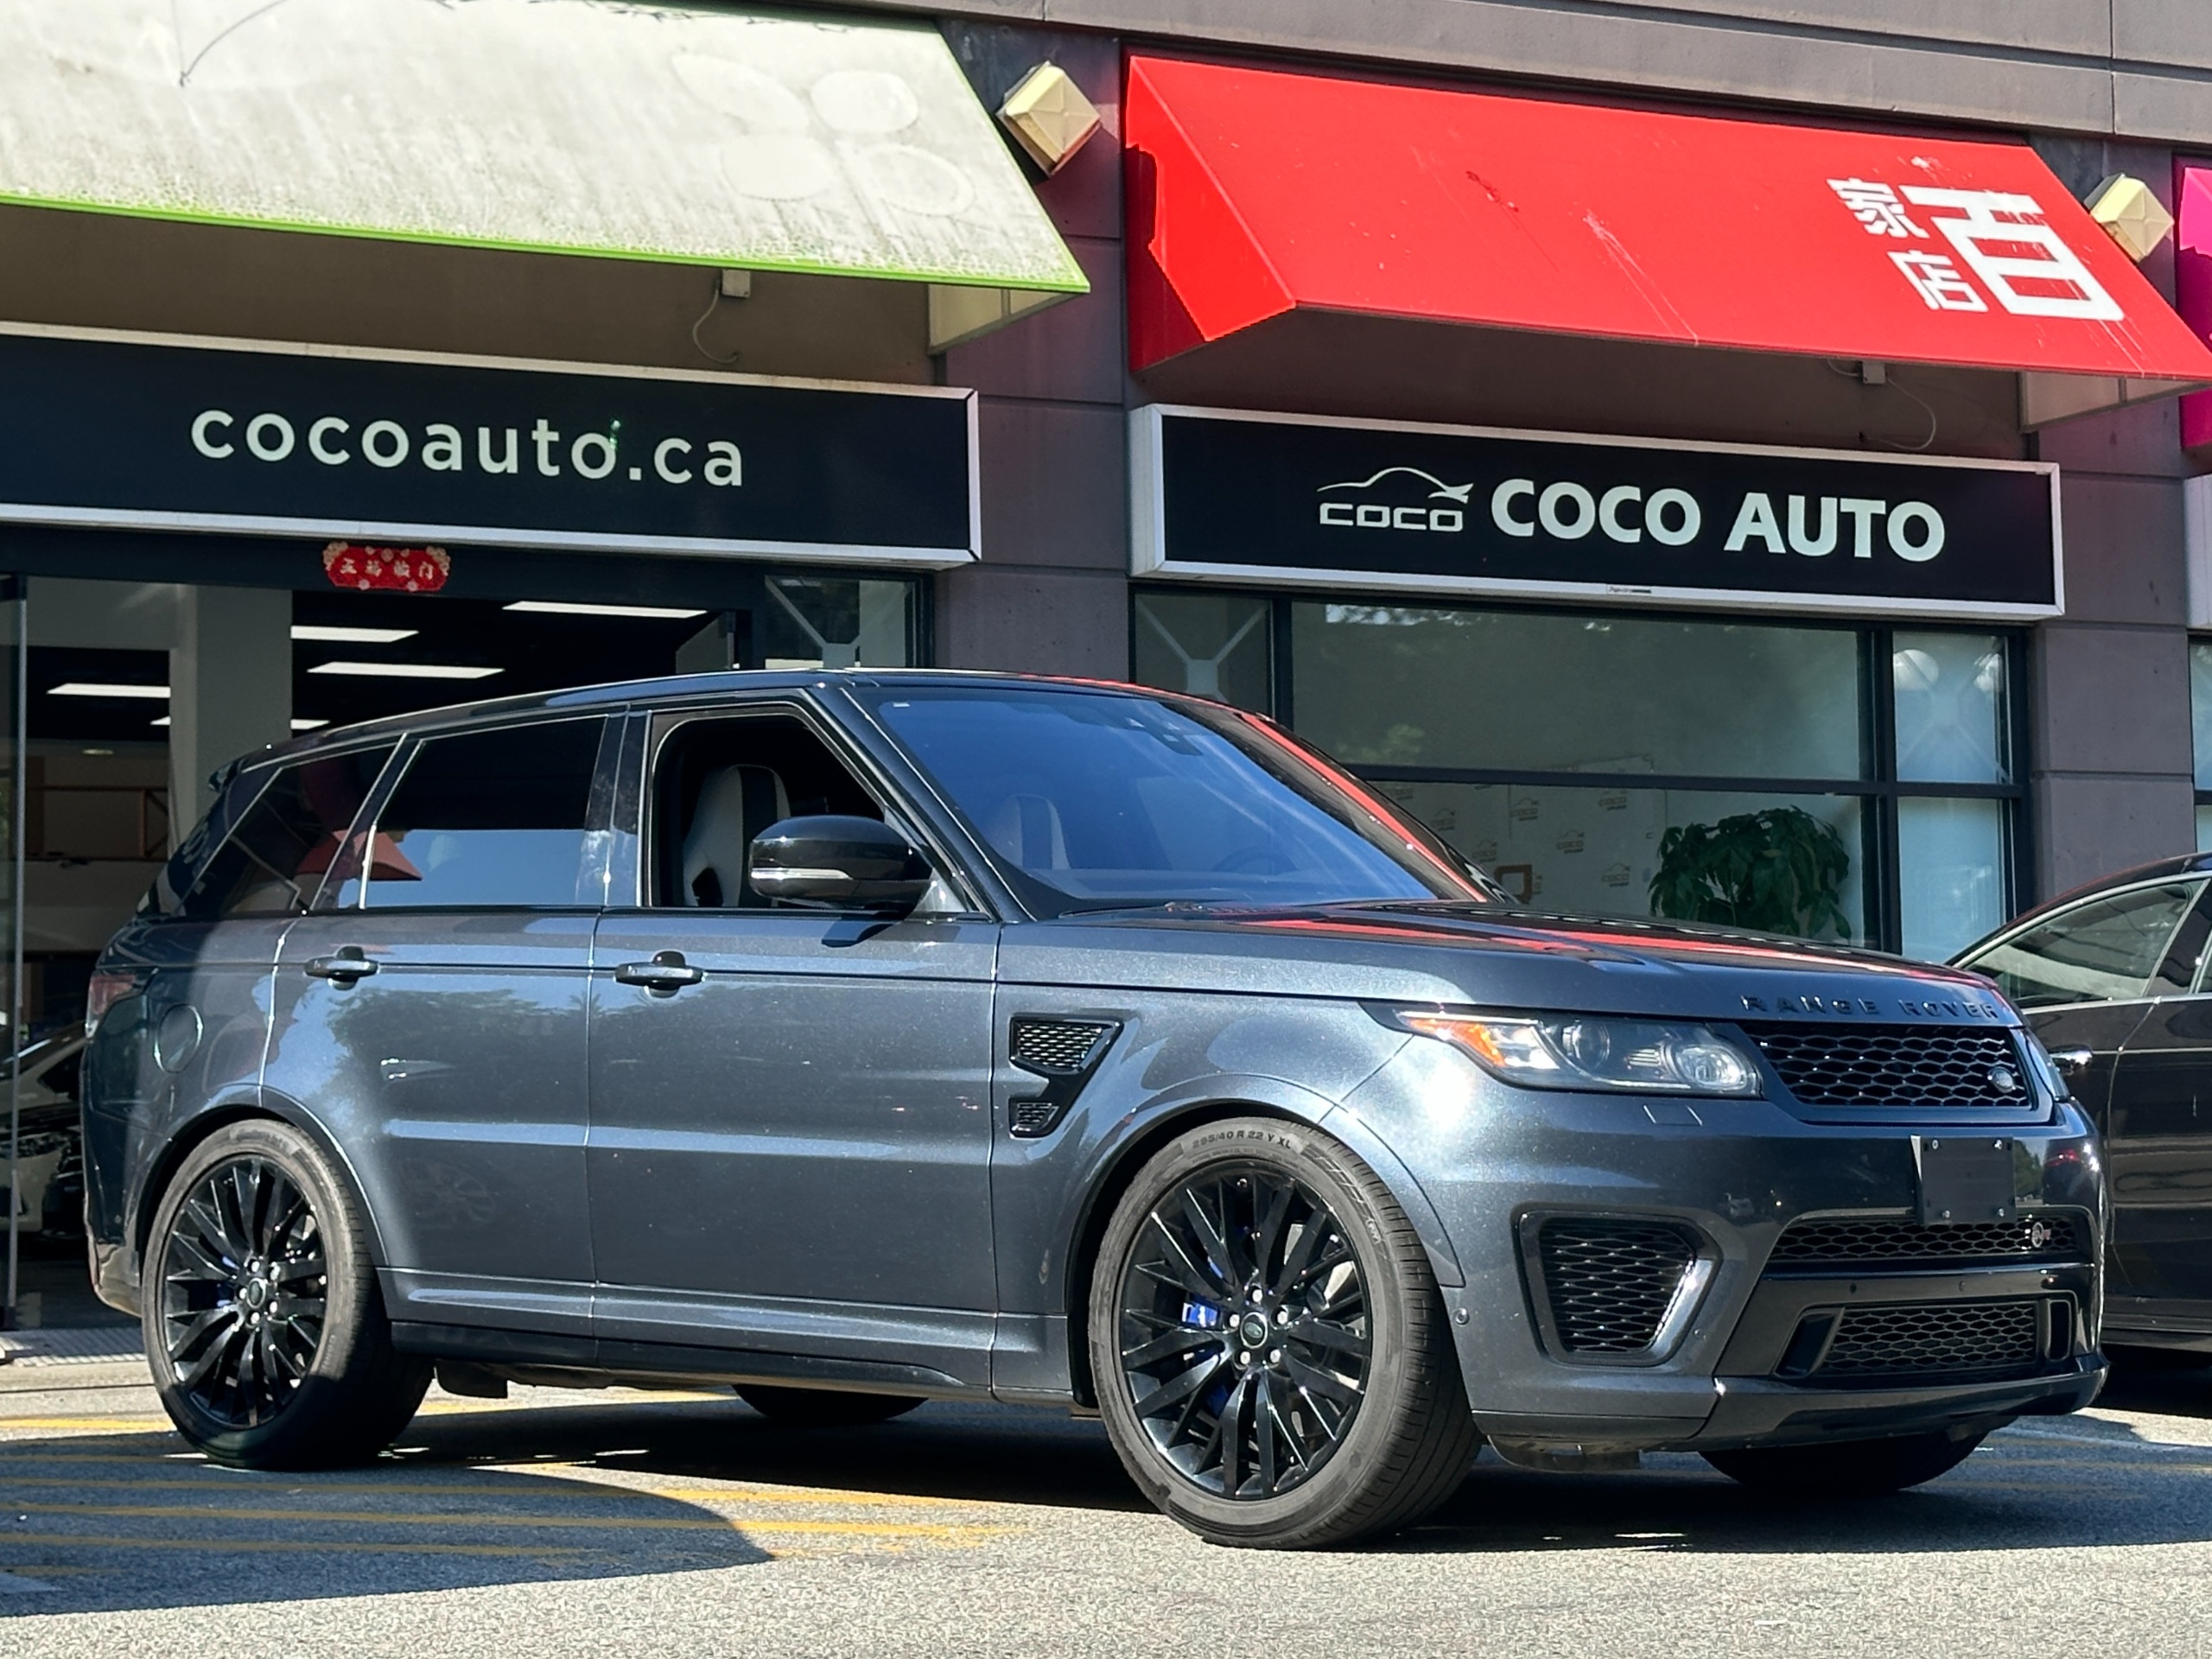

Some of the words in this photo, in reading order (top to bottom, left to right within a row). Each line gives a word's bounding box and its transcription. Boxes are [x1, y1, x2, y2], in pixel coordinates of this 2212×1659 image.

[1827, 176, 1989, 312] 家店
[191, 410, 743, 487] cocoauto.ca
[1319, 502, 1464, 532] COCO
[1491, 478, 1701, 546] COCO
[1723, 492, 1947, 563] AUTO
[1738, 995, 1880, 1015] RANGE
[1898, 999, 1999, 1019] ROVER
